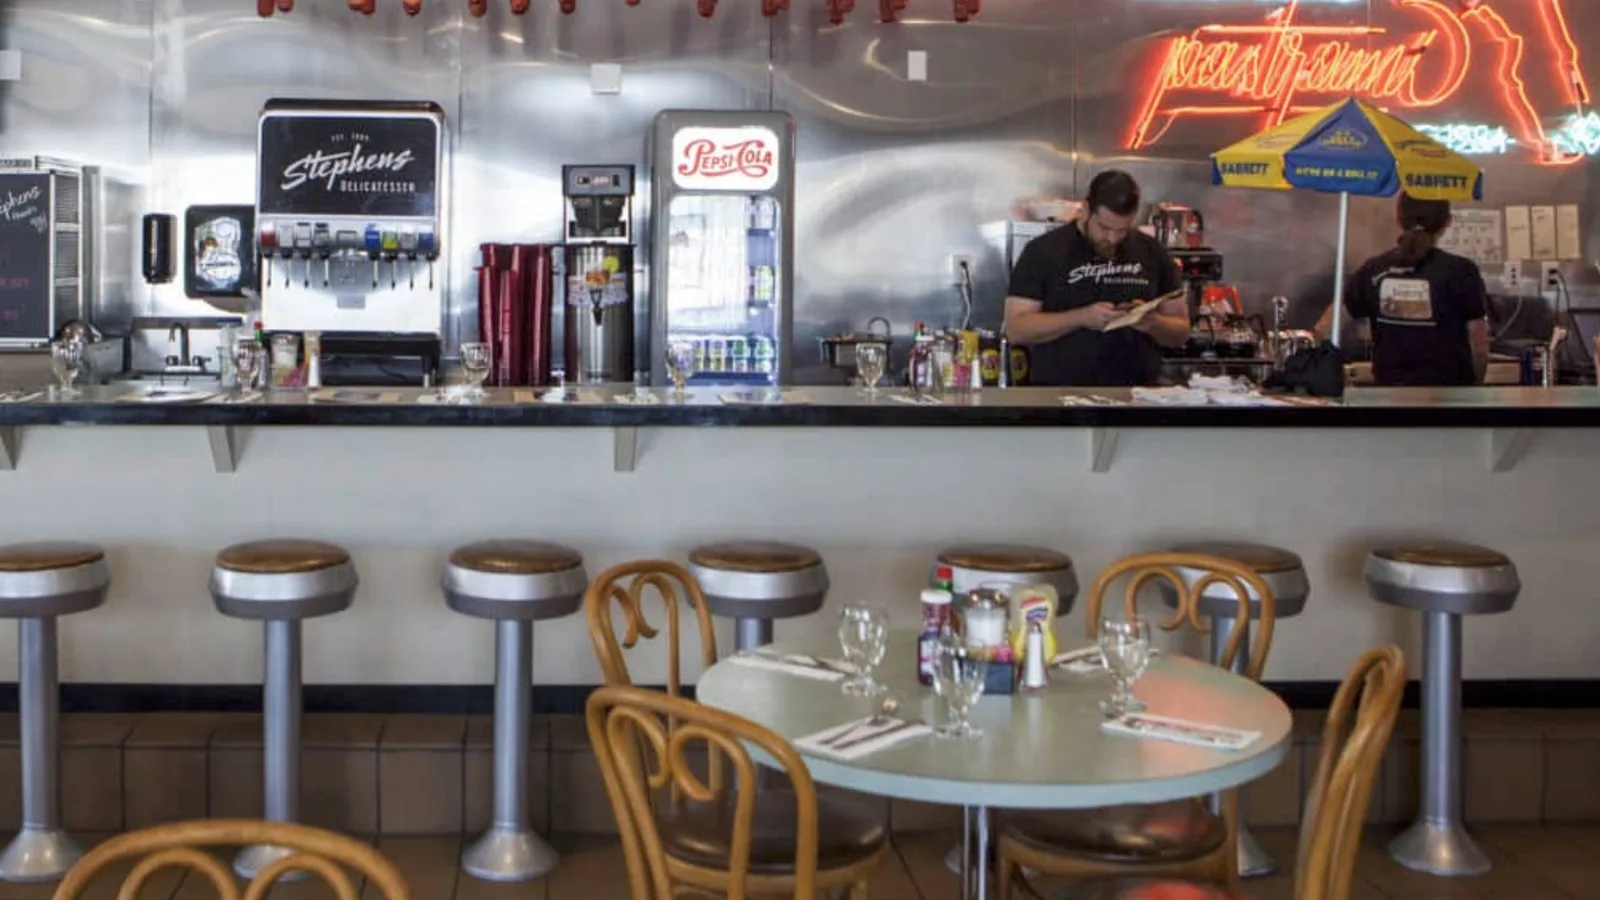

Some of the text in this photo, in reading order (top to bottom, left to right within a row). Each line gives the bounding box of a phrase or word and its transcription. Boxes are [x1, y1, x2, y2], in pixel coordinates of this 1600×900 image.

[1127, 14, 1443, 132] pastrami
[281, 142, 415, 191] Stephens
[340, 179, 415, 192] DELICATESSEN
